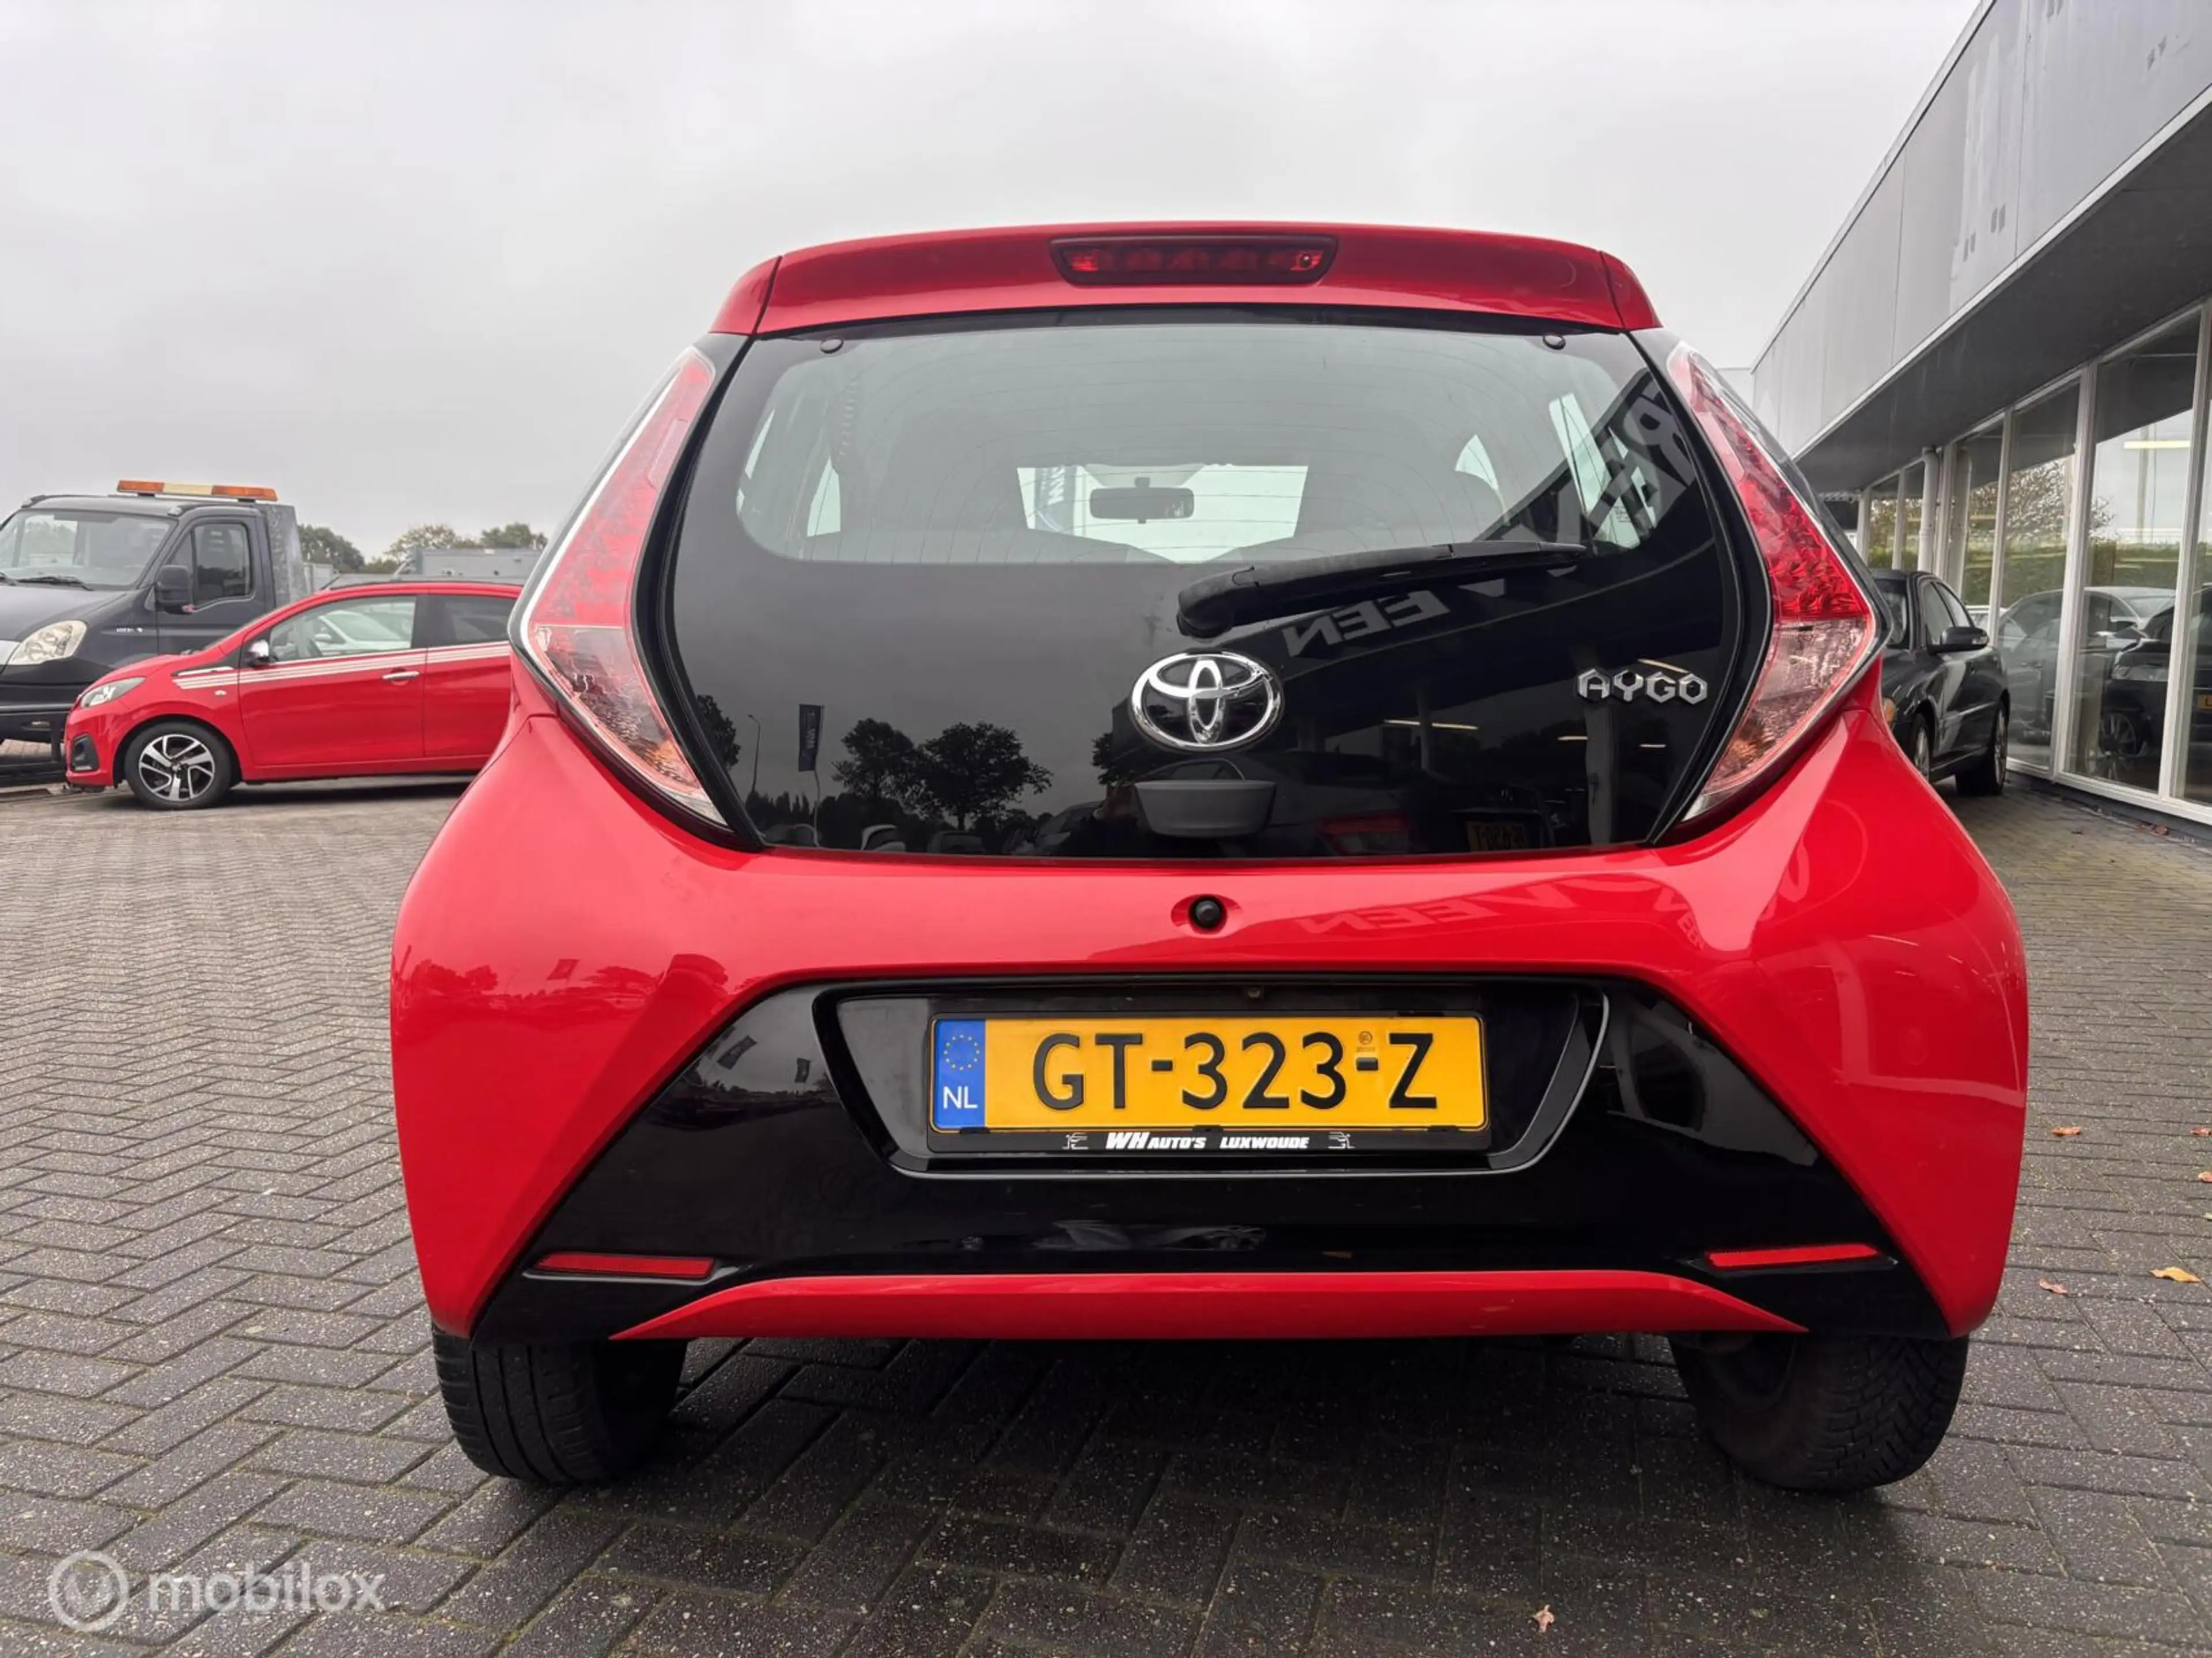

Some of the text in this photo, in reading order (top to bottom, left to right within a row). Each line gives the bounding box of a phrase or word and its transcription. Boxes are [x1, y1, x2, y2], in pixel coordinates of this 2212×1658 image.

[1578, 669, 1708, 705] AYGO
[1033, 1032, 1438, 1110] GT-323-Z
[943, 1086, 978, 1109] NL
[1147, 1137, 1207, 1149] AUTO'S
[1219, 1137, 1310, 1149] LUXWOUDE
